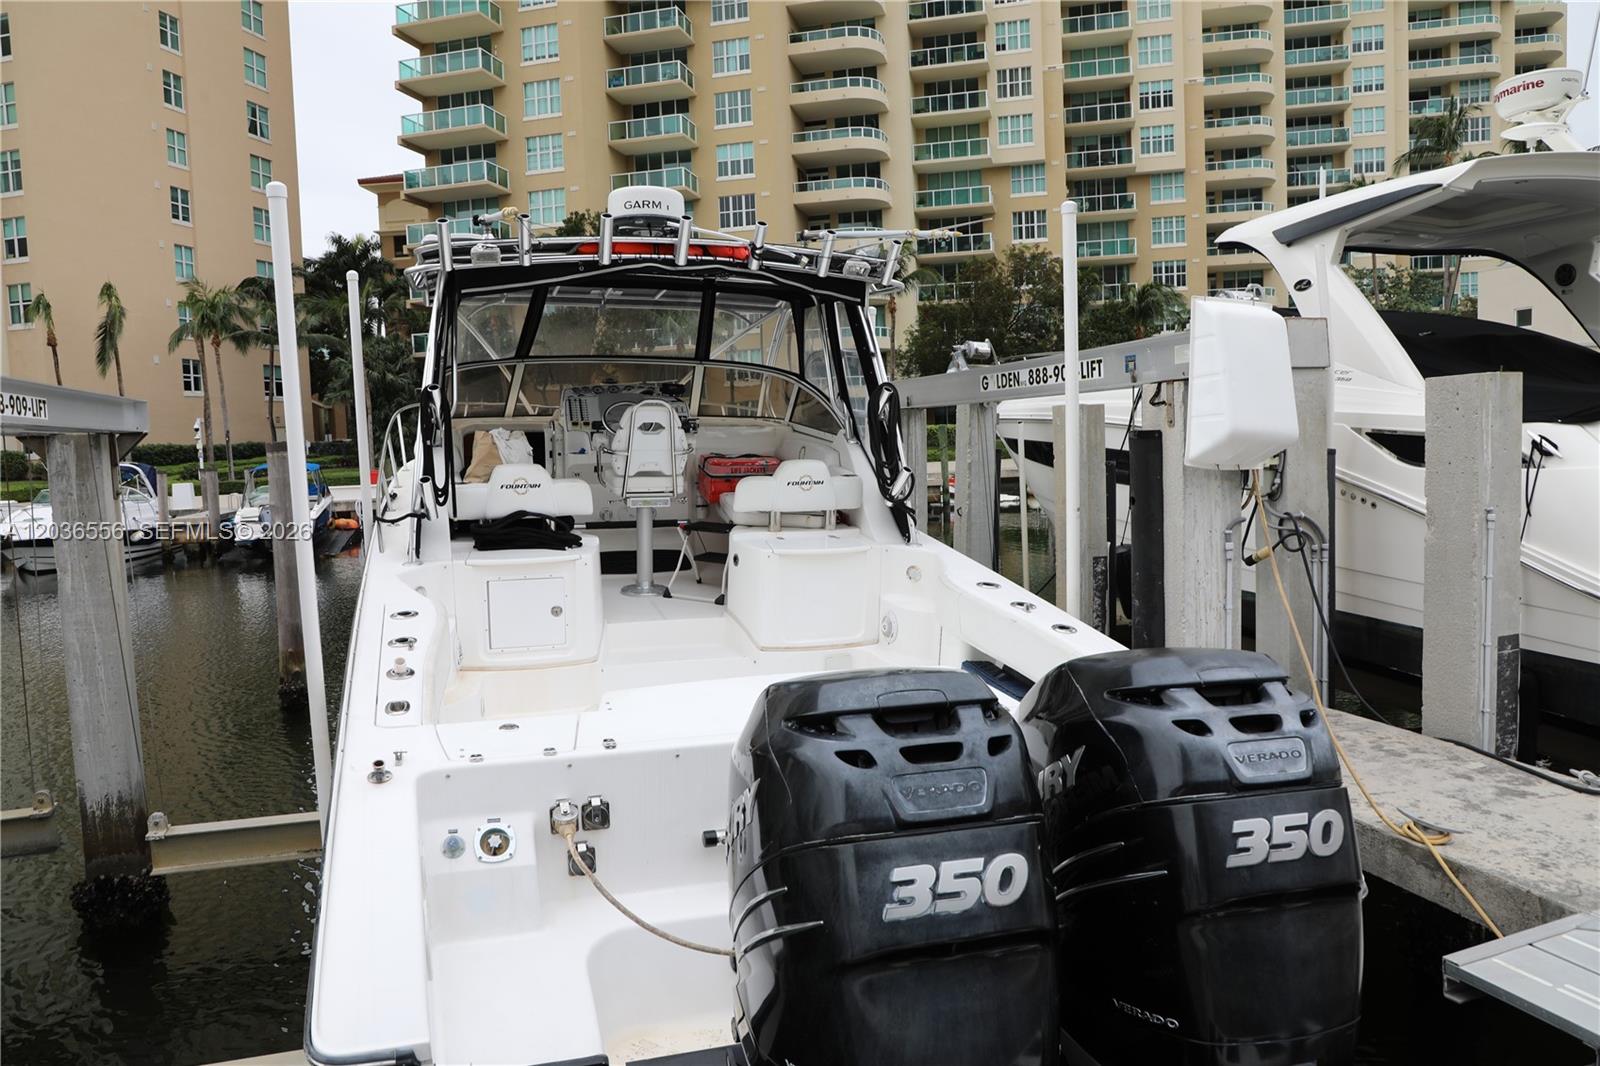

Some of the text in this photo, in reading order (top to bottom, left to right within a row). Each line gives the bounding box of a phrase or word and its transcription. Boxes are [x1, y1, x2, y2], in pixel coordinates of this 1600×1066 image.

[981, 371, 1020, 391] GLDEN
[1235, 750, 1302, 764] VERADO
[902, 781, 983, 800] VERADO
[1226, 808, 1345, 869] 350
[882, 853, 1028, 922] 350
